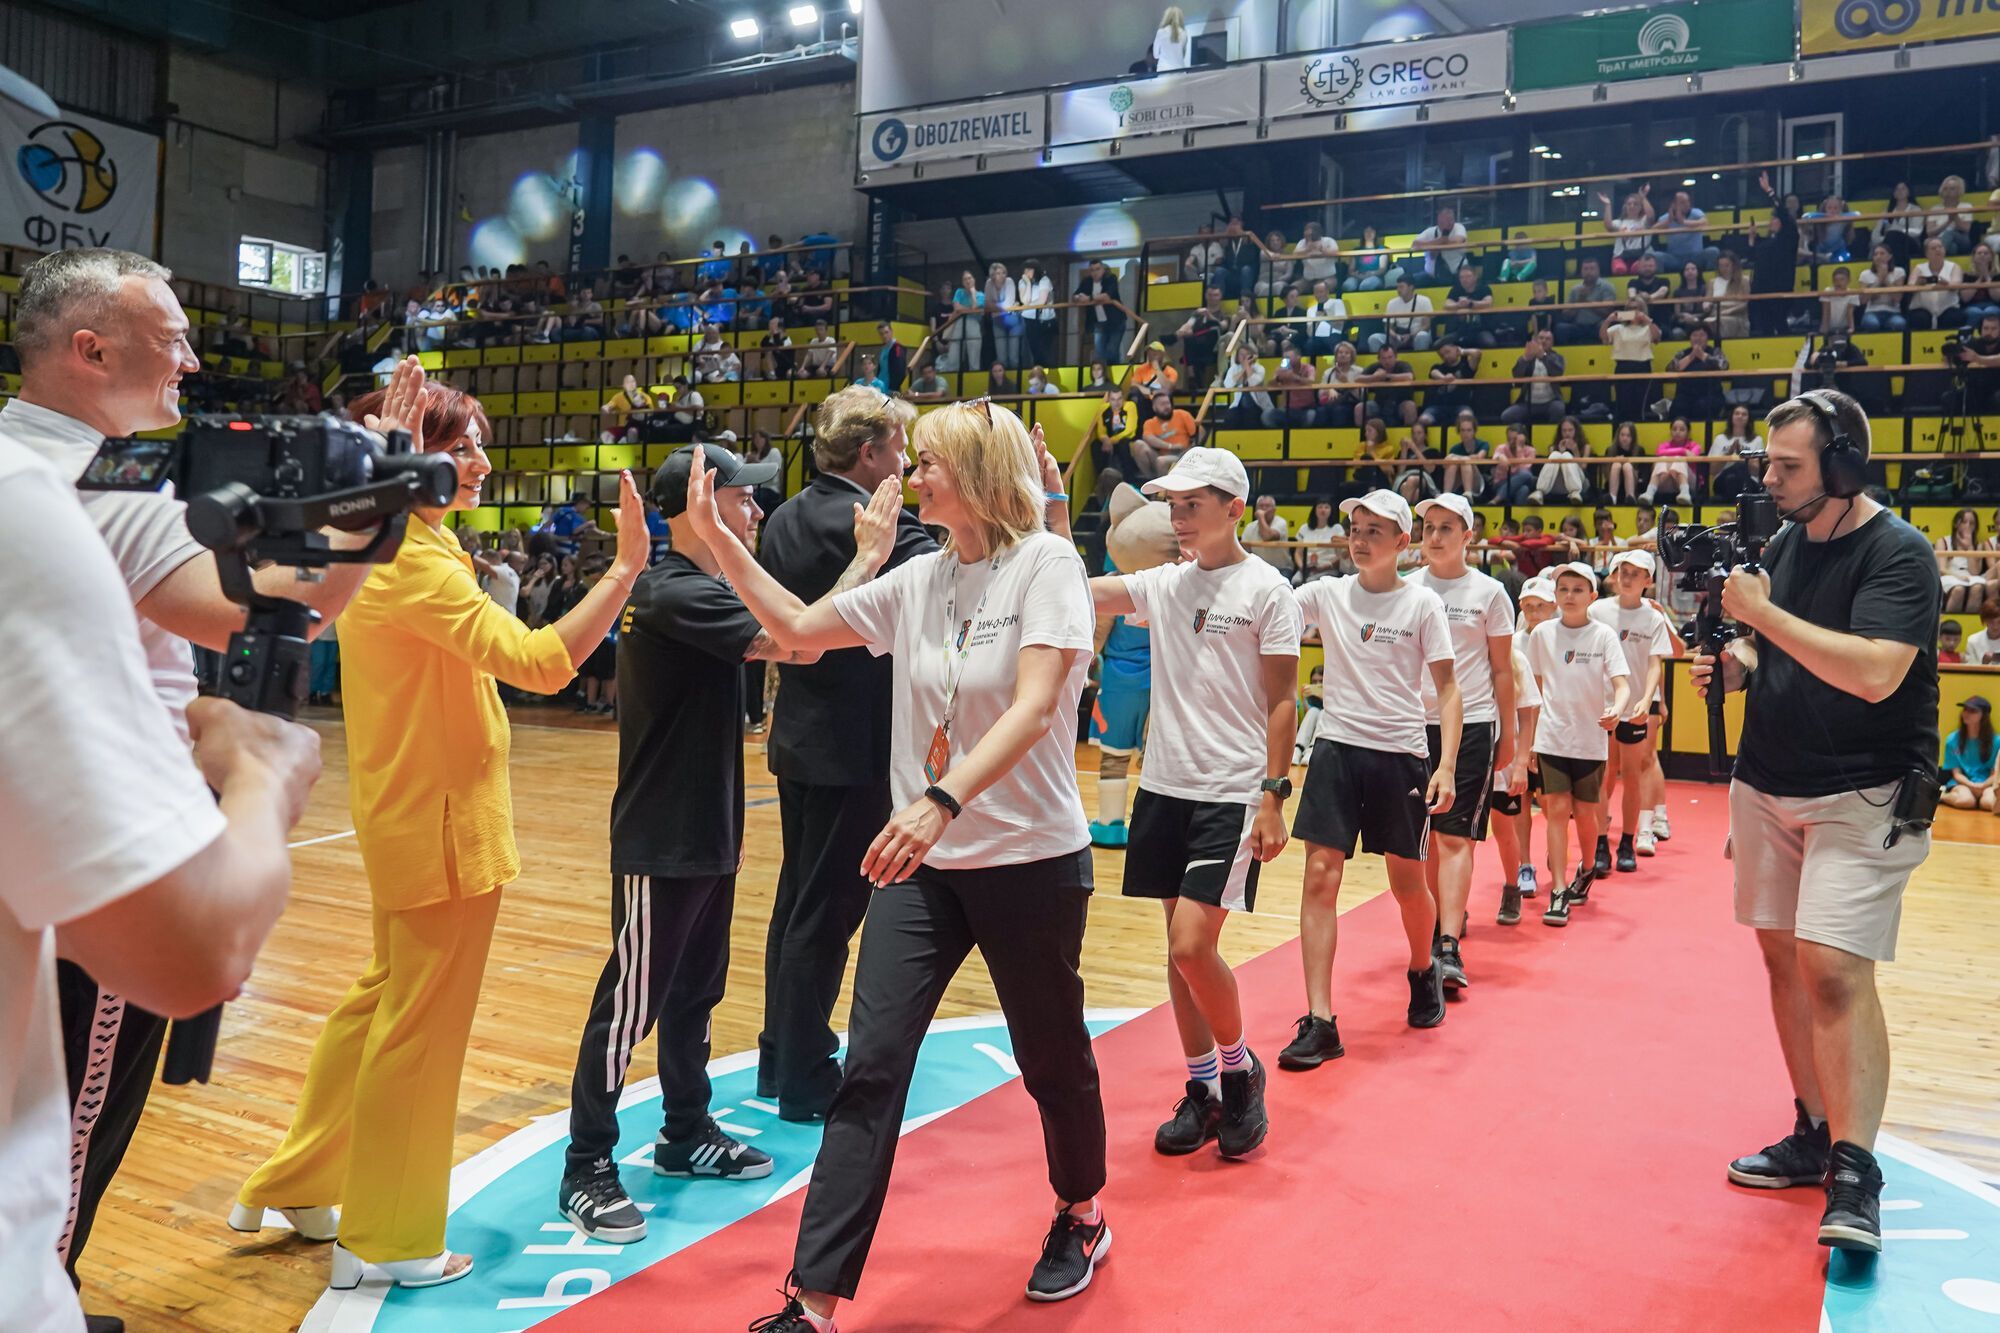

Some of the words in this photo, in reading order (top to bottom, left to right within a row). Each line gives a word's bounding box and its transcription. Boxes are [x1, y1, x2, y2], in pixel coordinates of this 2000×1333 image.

[1369, 53, 1469, 86] GRECO
[1598, 61, 1626, 74] ПрАТ
[1370, 88, 1395, 99] LAW
[1400, 80, 1466, 96] COMPANY
[1128, 109, 1157, 124] SOBI
[1160, 104, 1194, 120] CLUB
[915, 111, 1032, 148] OBOZREVATEL
[1922, 433, 1935, 441] 14
[329, 495, 376, 517] RONIN
